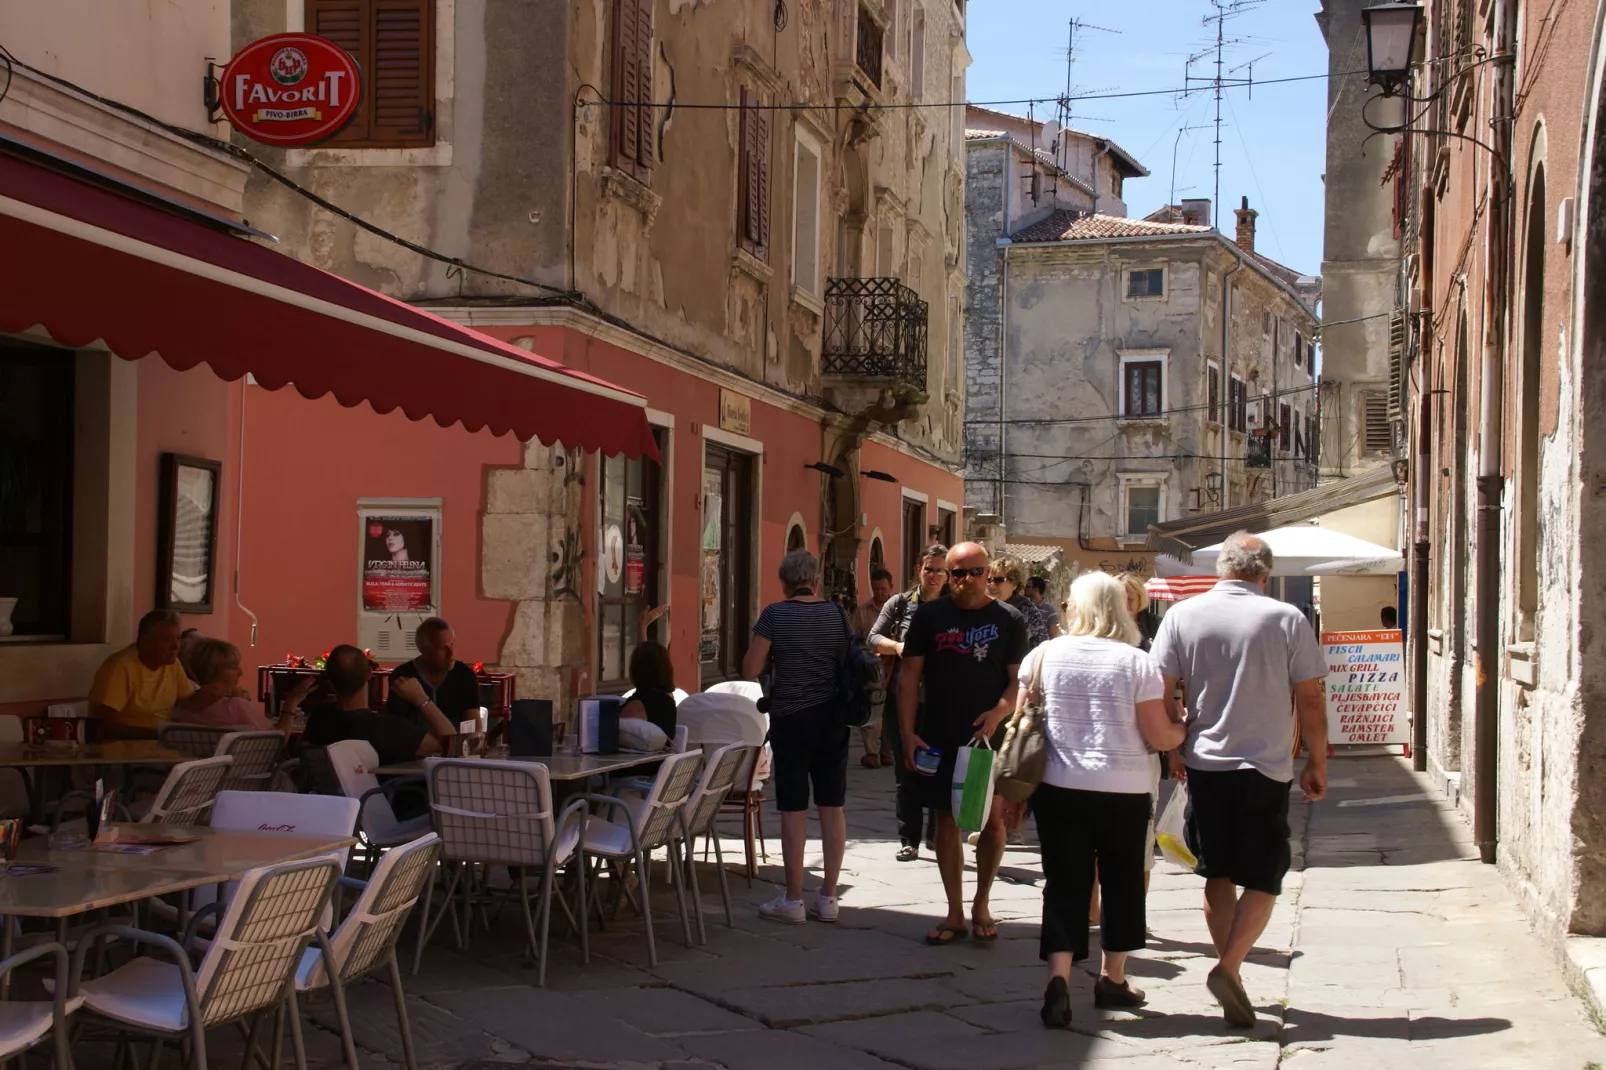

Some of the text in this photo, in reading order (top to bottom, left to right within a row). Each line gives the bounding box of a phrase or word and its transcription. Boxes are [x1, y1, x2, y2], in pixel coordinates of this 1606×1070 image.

[235, 71, 346, 110] FAVORIT
[265, 109, 308, 119] PIVO-BIRRA
[1327, 633, 1372, 642] PEČENJARA
[1328, 645, 1363, 655] FISCH
[1348, 653, 1400, 663] CALAMARI
[1328, 663, 1379, 673] MIX GRILL
[1348, 672, 1398, 683] PIZZA
[1330, 684, 1380, 693] SALATE
[1330, 692, 1401, 702] PLJESKAVICA
[1341, 724, 1395, 733] RAMSTEK
[1348, 733, 1388, 742] OMLET
